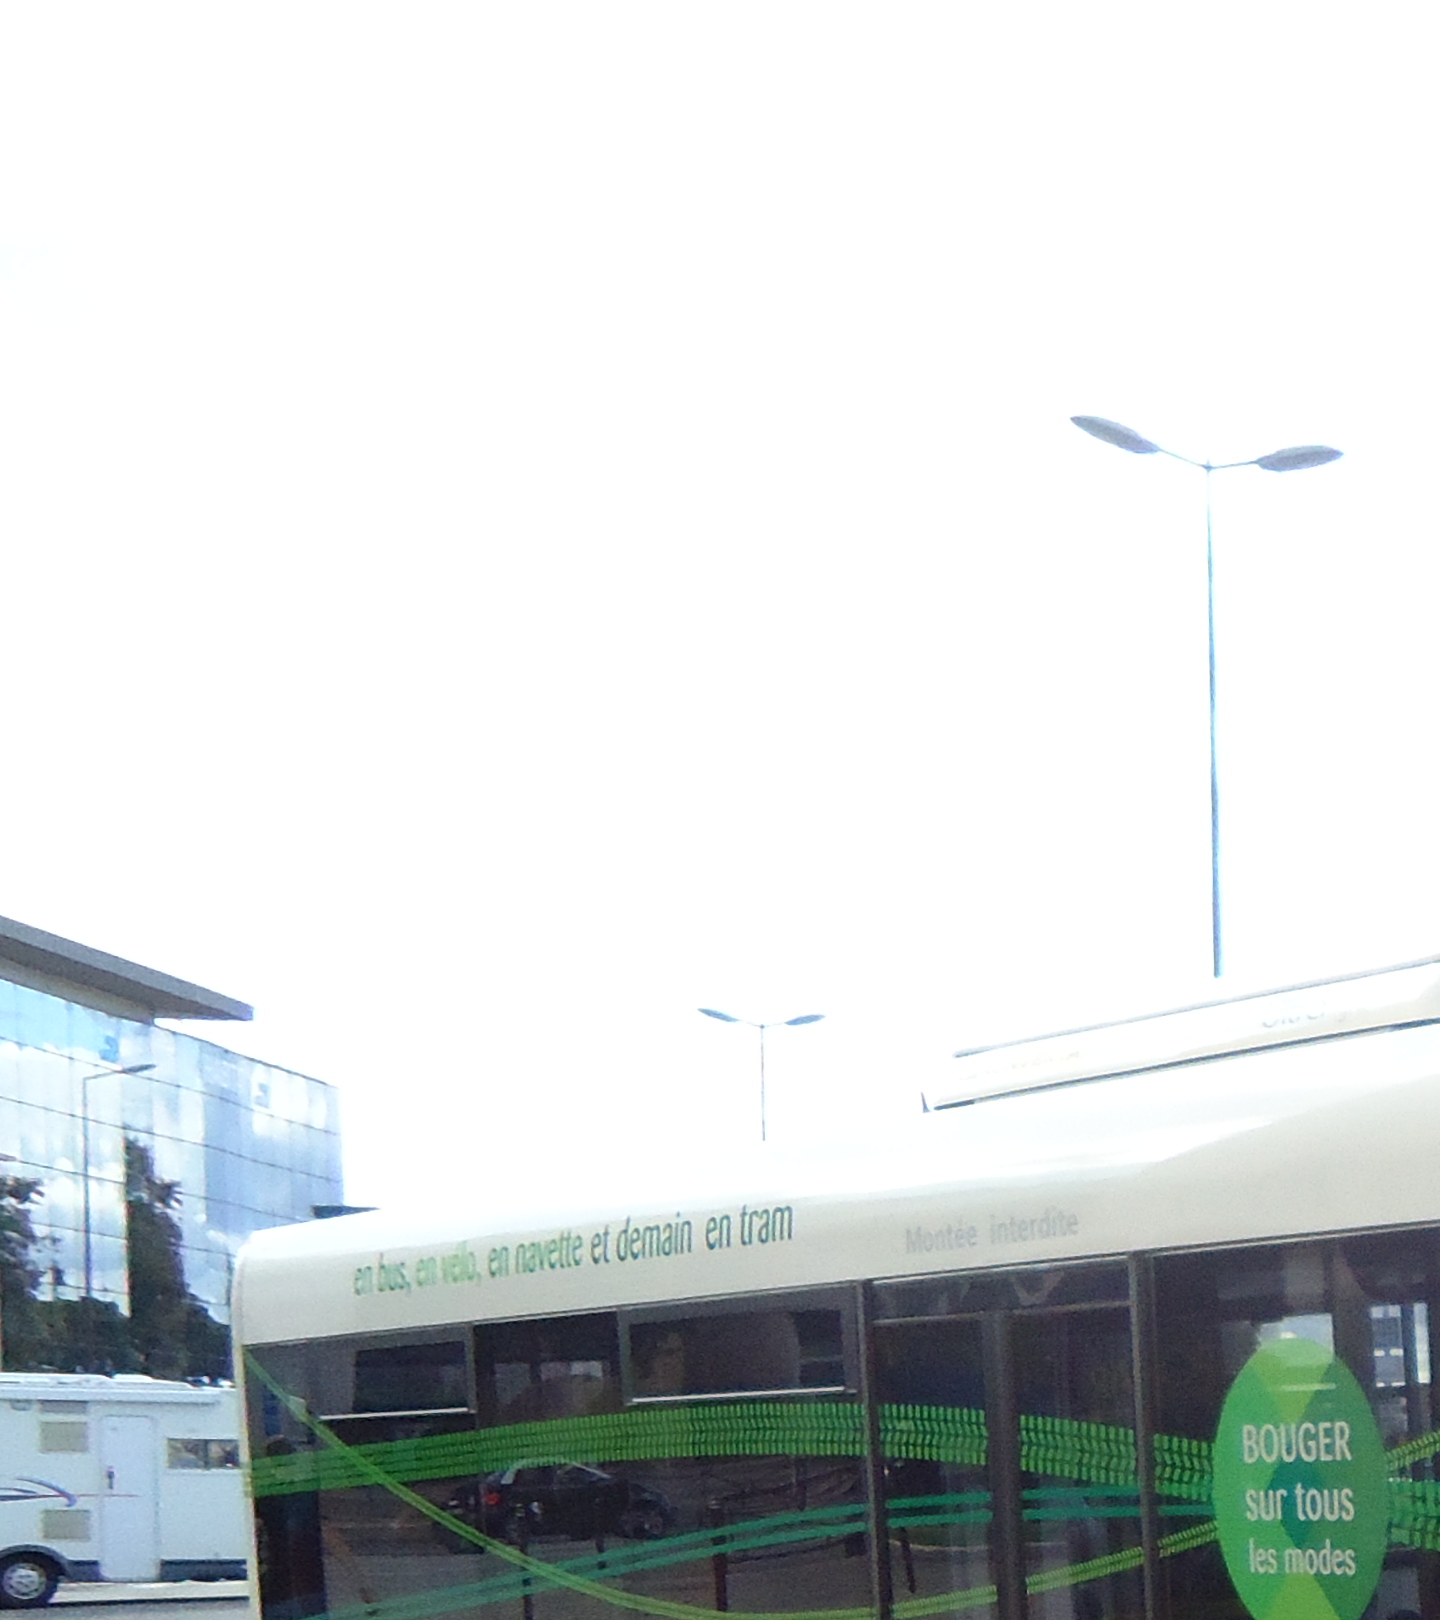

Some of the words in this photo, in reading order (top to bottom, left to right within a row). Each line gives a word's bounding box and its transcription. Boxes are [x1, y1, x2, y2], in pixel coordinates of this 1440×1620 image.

[354, 1265, 374, 1296] en
[488, 1246, 509, 1278] en
[515, 1229, 584, 1274] navette
[590, 1224, 611, 1265] et
[616, 1211, 692, 1262] demain
[705, 1214, 732, 1250] en
[739, 1204, 793, 1246] tram
[905, 1218, 978, 1254] Montée
[990, 1206, 1079, 1244] interdite
[1242, 1421, 1353, 1464] BOUGER
[1245, 1488, 1288, 1522] sur
[1295, 1482, 1355, 1522] tous
[1249, 1538, 1277, 1574] les
[1284, 1538, 1356, 1576] modes
